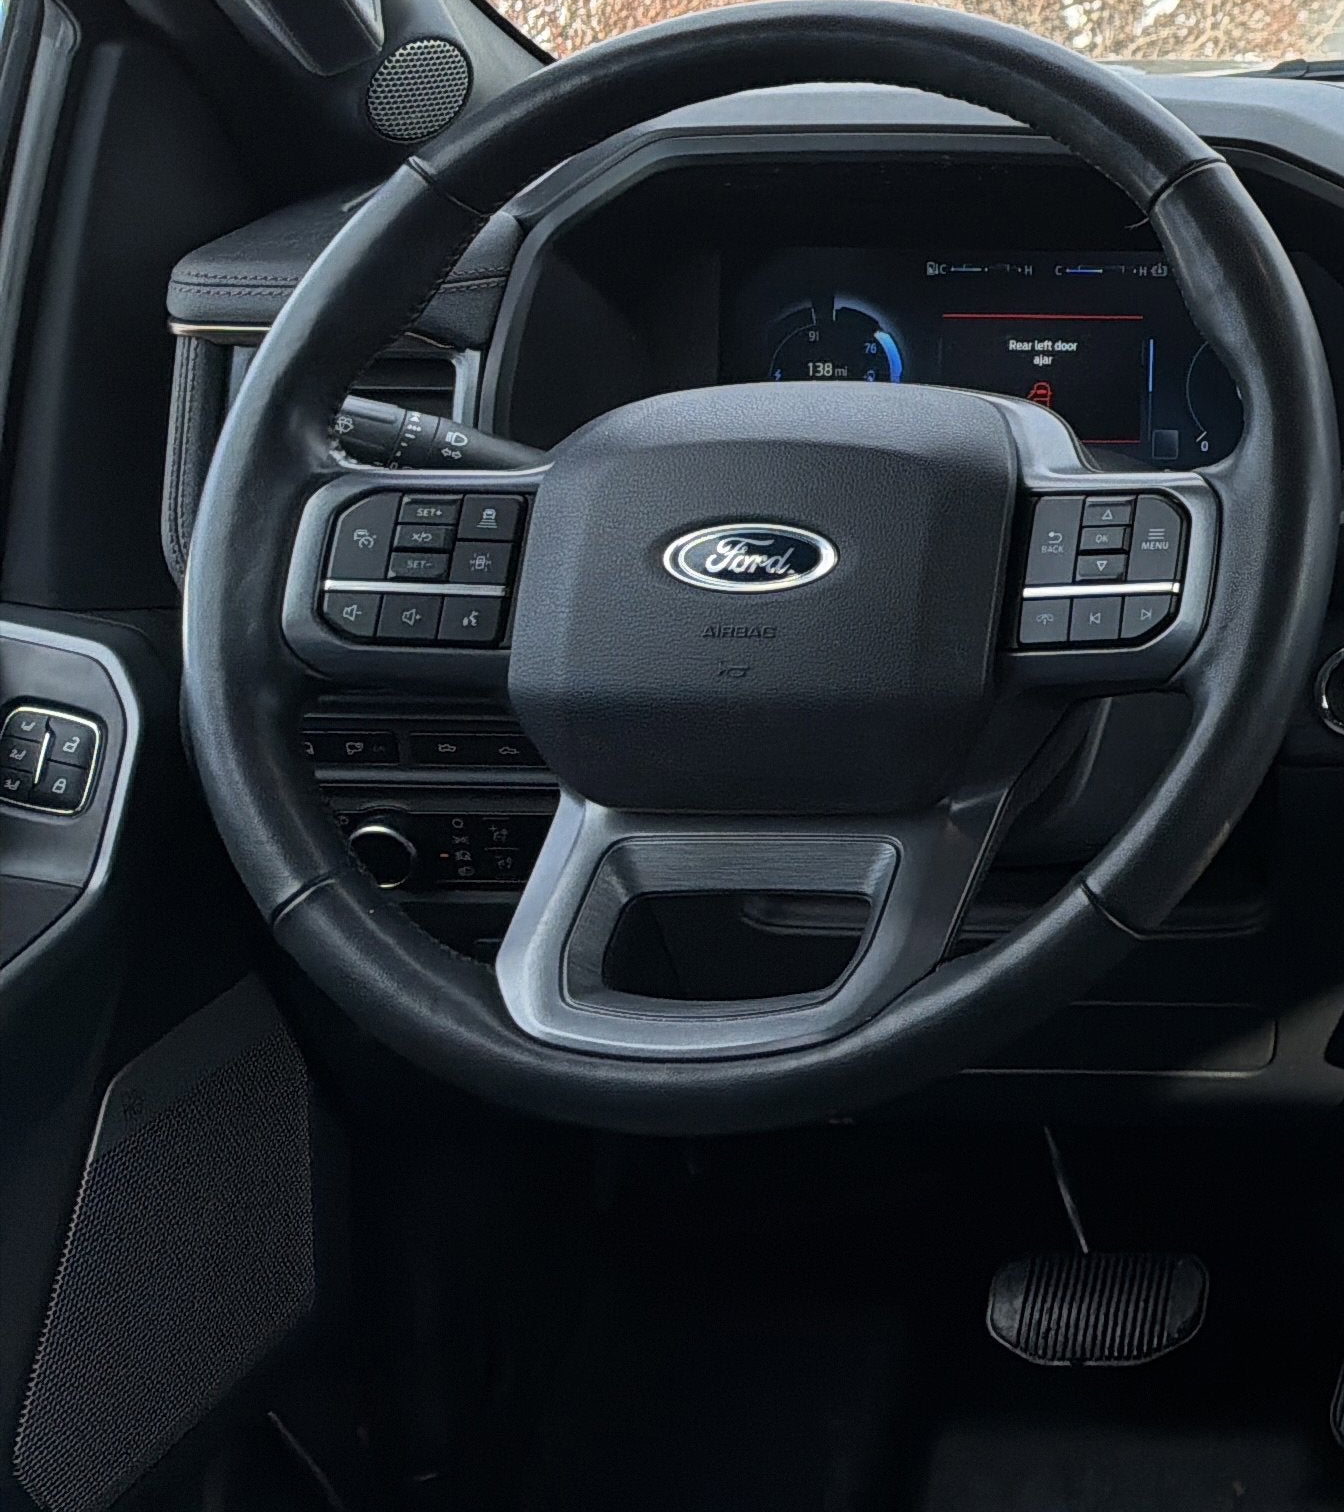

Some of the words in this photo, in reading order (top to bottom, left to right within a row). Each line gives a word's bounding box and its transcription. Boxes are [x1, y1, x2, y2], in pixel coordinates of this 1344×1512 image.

[808, 330, 819, 342] 91
[1008, 339, 1032, 351] Rear
[1034, 339, 1052, 351] left
[1054, 339, 1078, 352] door
[1033, 354, 1053, 366] ajar
[808, 362, 833, 377] 138
[834, 365, 848, 377] mi
[1095, 533, 1109, 543] OK
[1041, 544, 1064, 554] BACK
[1141, 540, 1169, 551] MENU
[705, 537, 792, 574] Ford
[702, 624, 777, 639] AIRBAG
